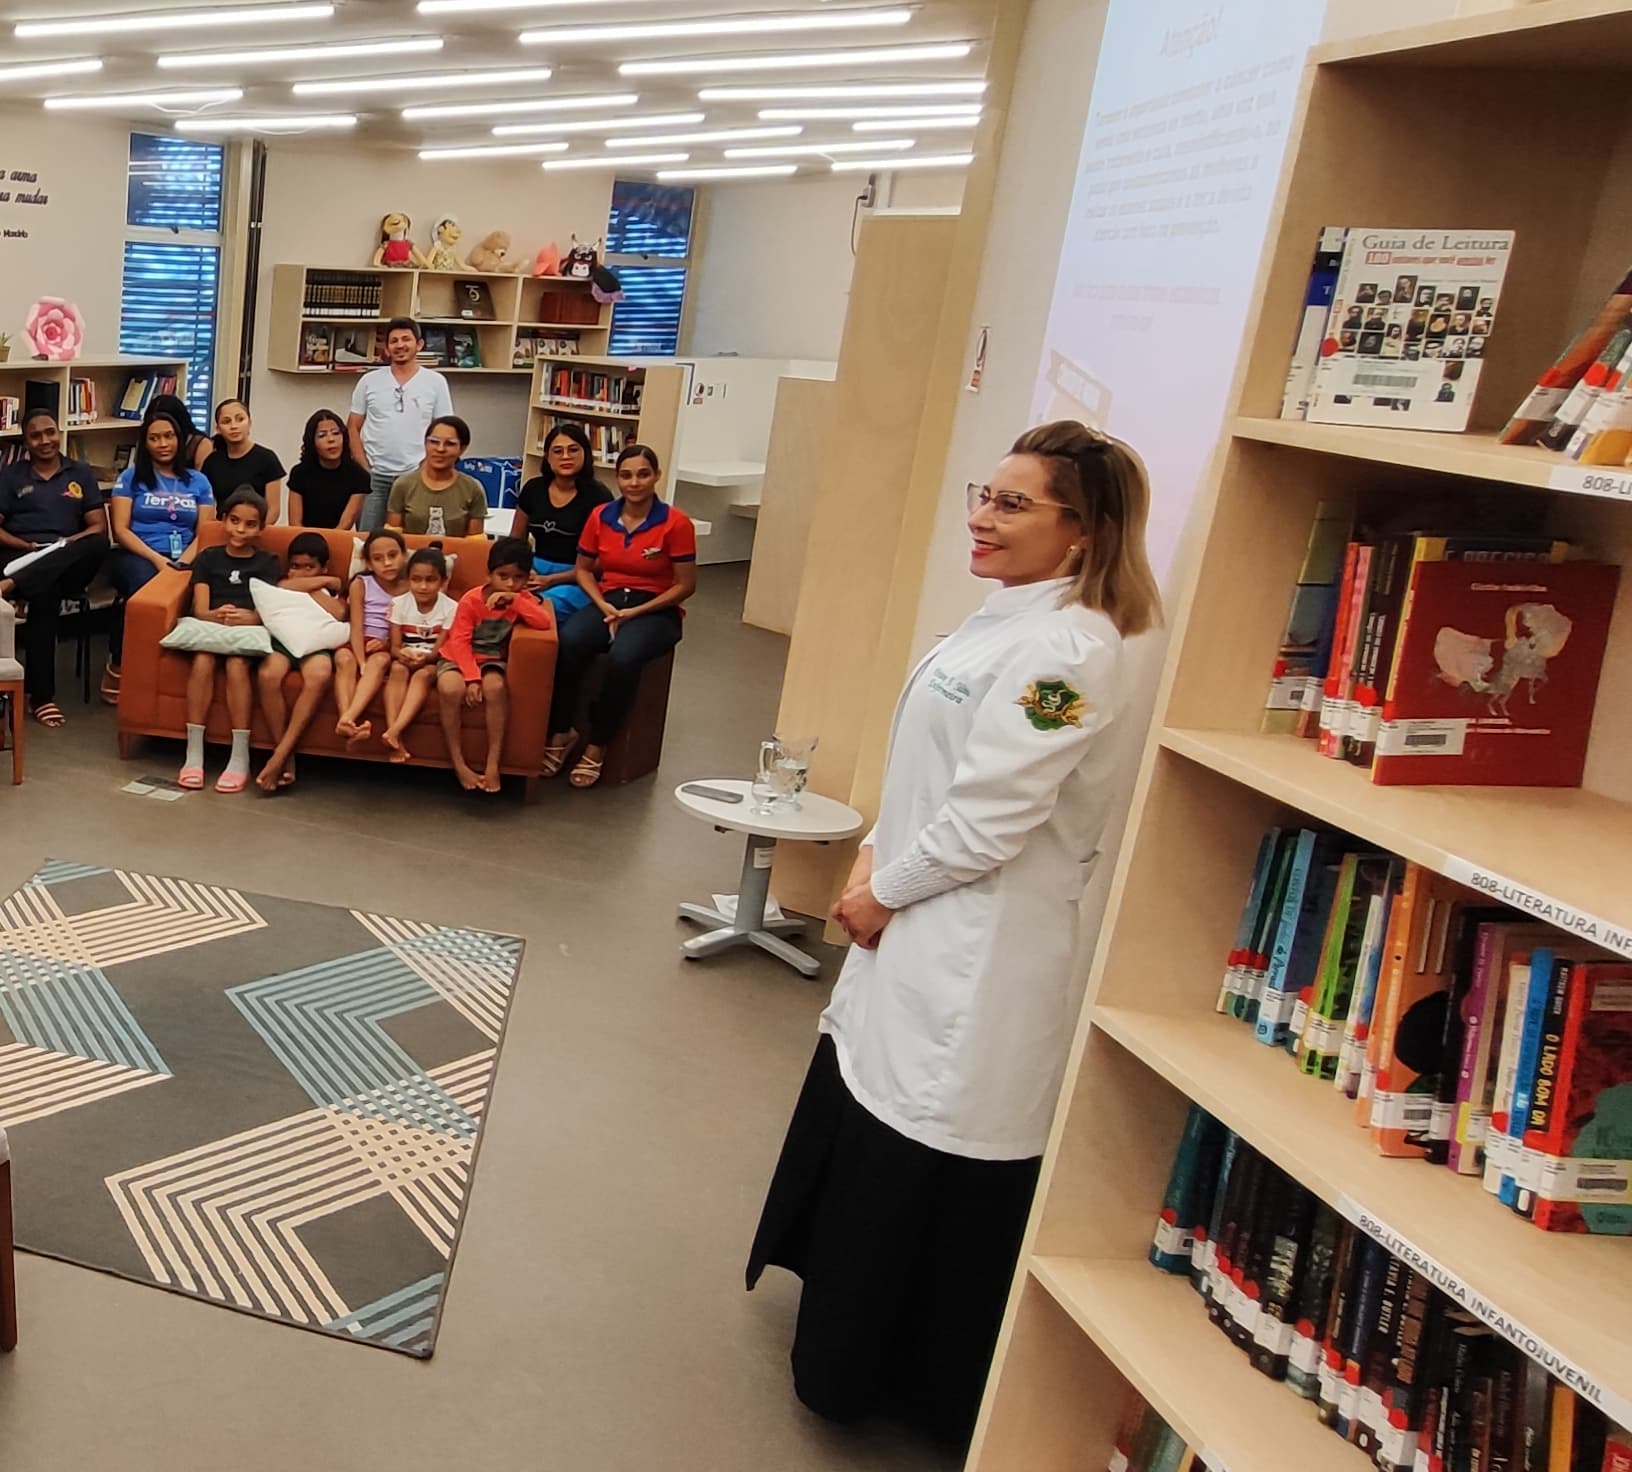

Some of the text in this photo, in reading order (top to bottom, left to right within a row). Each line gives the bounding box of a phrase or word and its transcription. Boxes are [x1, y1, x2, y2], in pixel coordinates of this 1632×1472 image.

[1362, 234, 1509, 251] Guia de Leitura
[1470, 872, 1597, 938] 808-LITERATURA
[1539, 1045, 1559, 1076] LADO
[1534, 1078, 1552, 1106] BOM
[1530, 1108, 1547, 1126] DA
[1359, 1213, 1467, 1302] 808-LITERATURA
